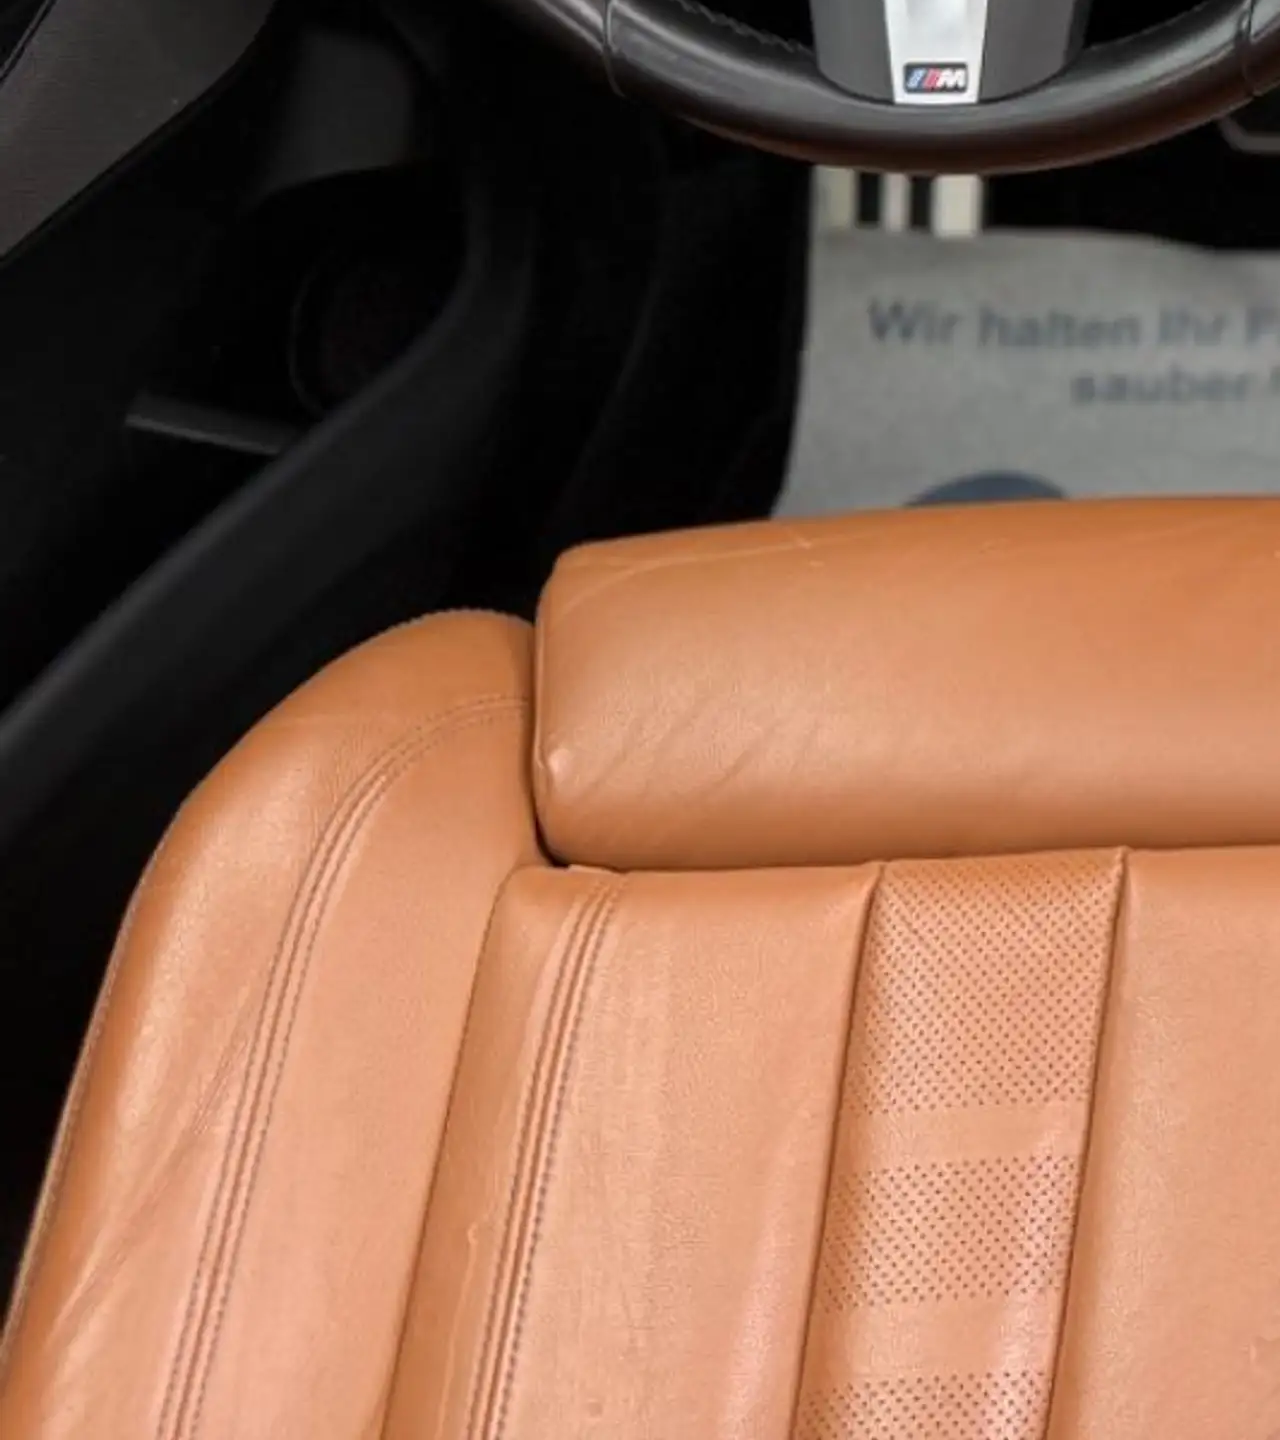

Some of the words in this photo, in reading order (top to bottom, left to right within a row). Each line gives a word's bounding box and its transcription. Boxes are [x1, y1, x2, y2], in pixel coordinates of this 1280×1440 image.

[867, 298, 958, 344] Wir
[977, 304, 1141, 350] halten
[1158, 304, 1227, 348] Ihr
[1071, 366, 1252, 406] sauber
